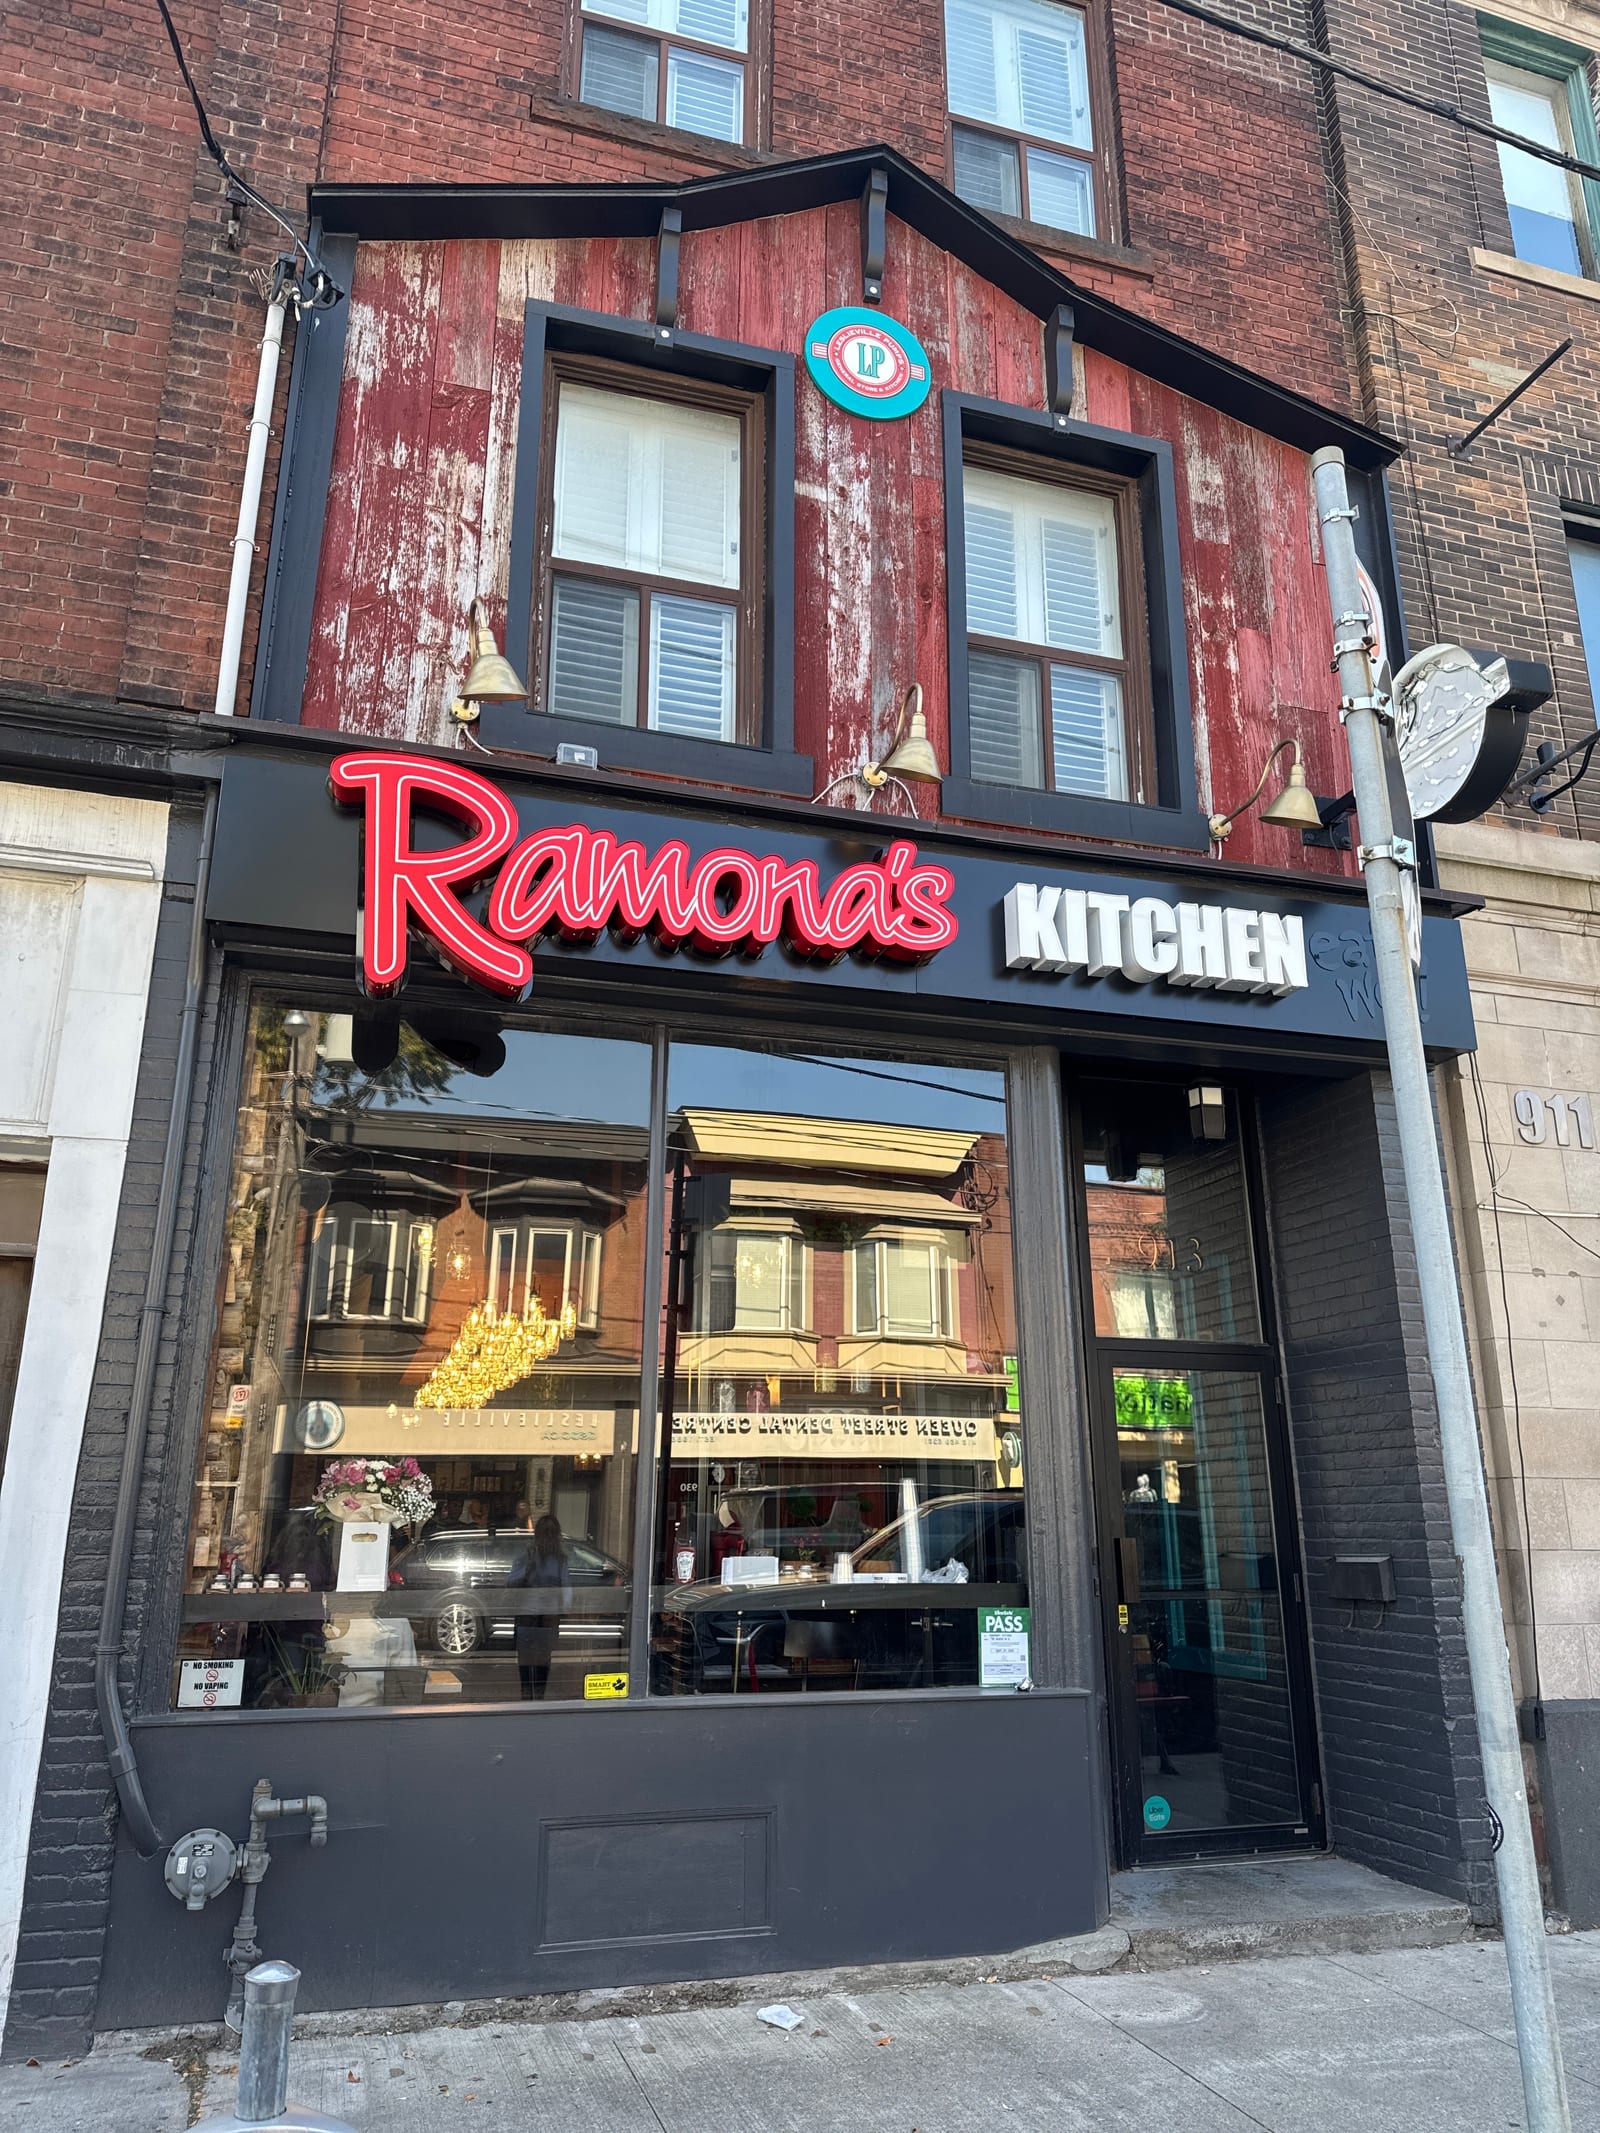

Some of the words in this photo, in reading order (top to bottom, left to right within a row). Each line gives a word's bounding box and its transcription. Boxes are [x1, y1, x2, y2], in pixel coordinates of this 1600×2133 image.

[834, 329, 882, 350] LESLIEVILLE
[883, 338, 905, 365] PUMPS
[857, 343, 885, 378] LP
[330, 752, 960, 996] Ramona's
[1003, 882, 1310, 998] KITCHEN
[1513, 1089, 1594, 1150] 911
[1138, 1235, 1204, 1272] 913
[985, 1615, 1023, 1632] PASS
[193, 1661, 202, 1669] NO
[203, 1661, 234, 1669] SMOKING
[193, 1682, 203, 1690] NO
[204, 1682, 229, 1690] VAPING
